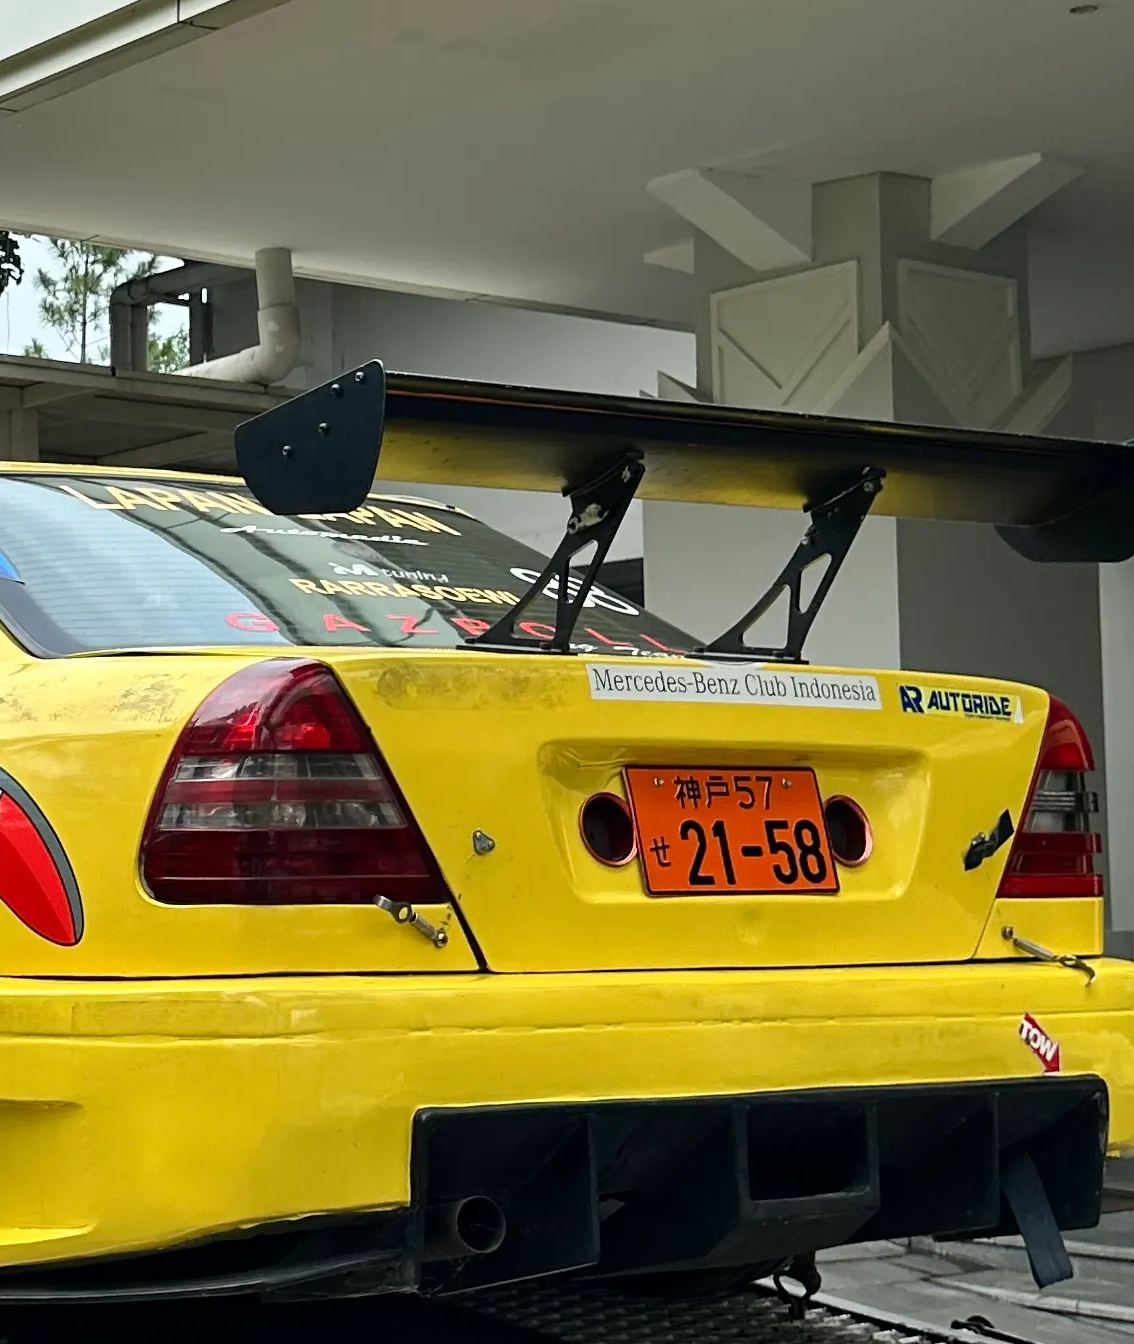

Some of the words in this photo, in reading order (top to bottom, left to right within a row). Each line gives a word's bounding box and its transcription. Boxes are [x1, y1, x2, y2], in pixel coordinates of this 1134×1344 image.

[592, 667, 741, 695] Mercedes-Benz
[744, 673, 787, 698] Club
[791, 676, 877, 702] Indonesia
[927, 690, 1012, 716] AUTORIDE
[649, 836, 672, 867] せ
[678, 819, 828, 886] 21-58
[1021, 1019, 1059, 1062] TOW
